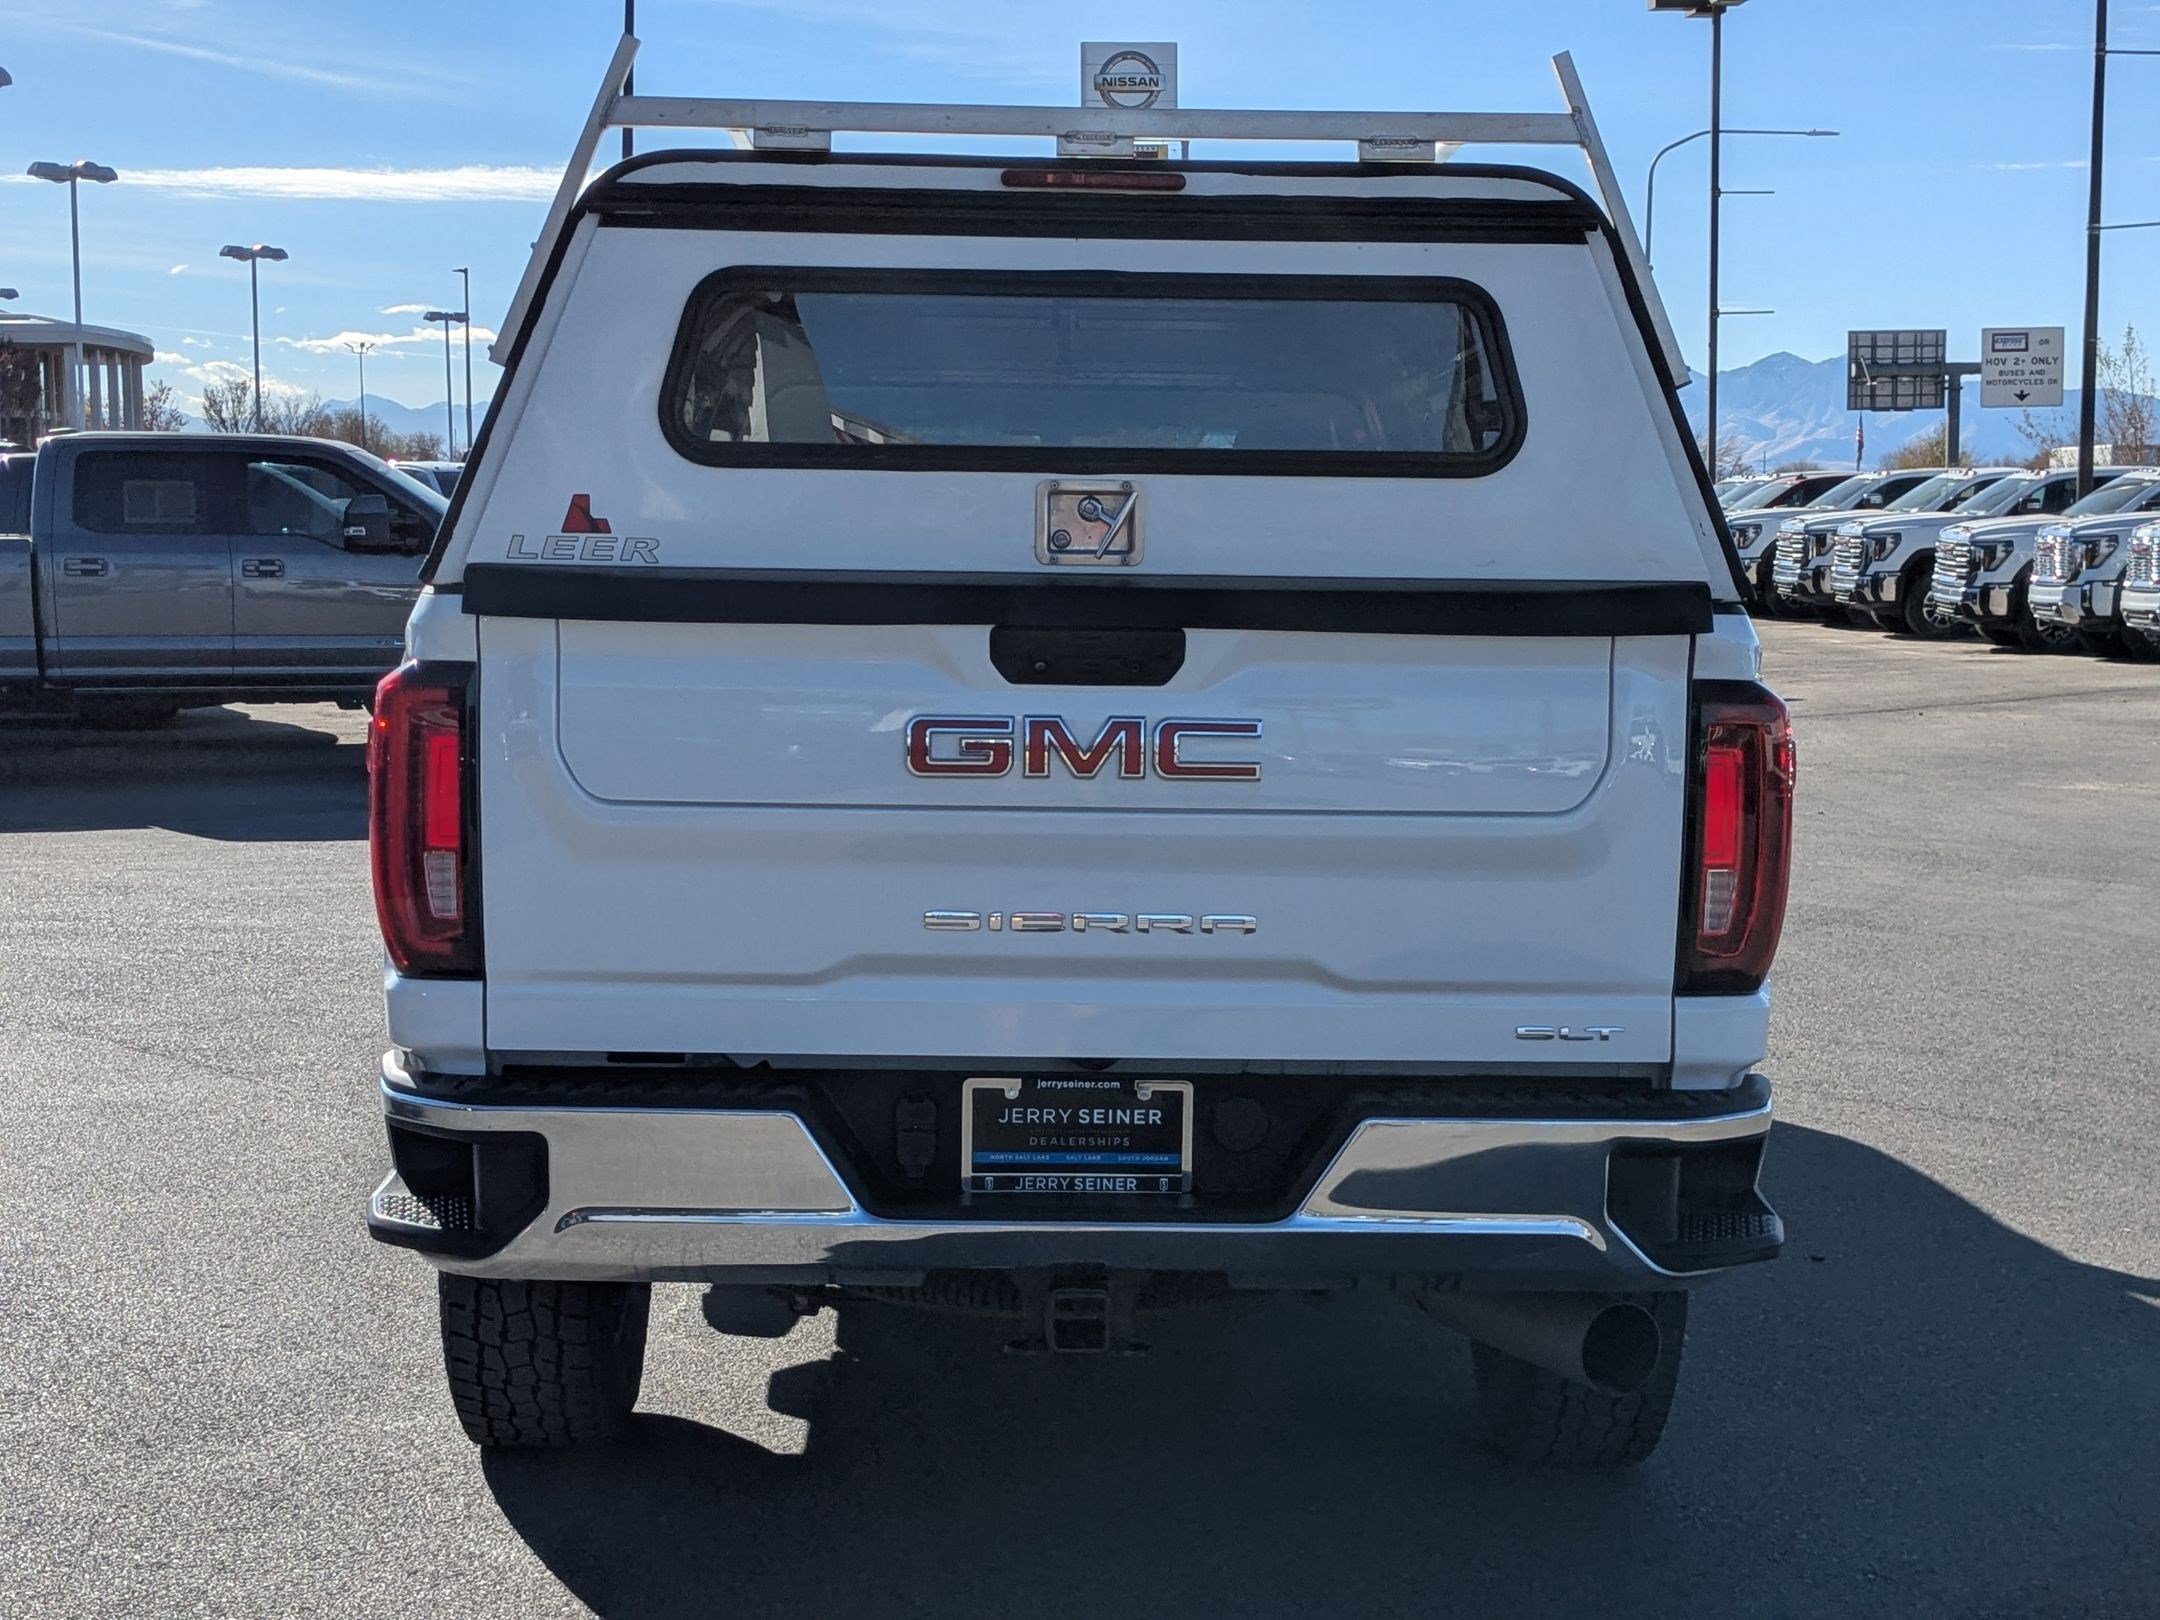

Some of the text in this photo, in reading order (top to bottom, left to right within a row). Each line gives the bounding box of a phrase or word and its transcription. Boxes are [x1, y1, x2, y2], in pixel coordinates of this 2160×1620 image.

[1102, 77, 1159, 87] NISSAN
[1985, 357, 2007, 366] HOV
[2031, 356, 2059, 365] ONLY
[1998, 369, 2025, 377] BUSES
[1985, 378, 2045, 386] MOTORCYCLES
[506, 534, 660, 564] LEER
[906, 713, 1263, 782] GMC
[923, 910, 1258, 935] SIERRA
[1515, 1025, 1625, 1041] SLT
[1036, 1078, 1120, 1089] jerryseiner.com
[998, 1108, 1162, 1125] JERRY SEINER
[1029, 1136, 1130, 1147] DEALERSHIPS
[1014, 1176, 1137, 1191] JERRY SEINER
